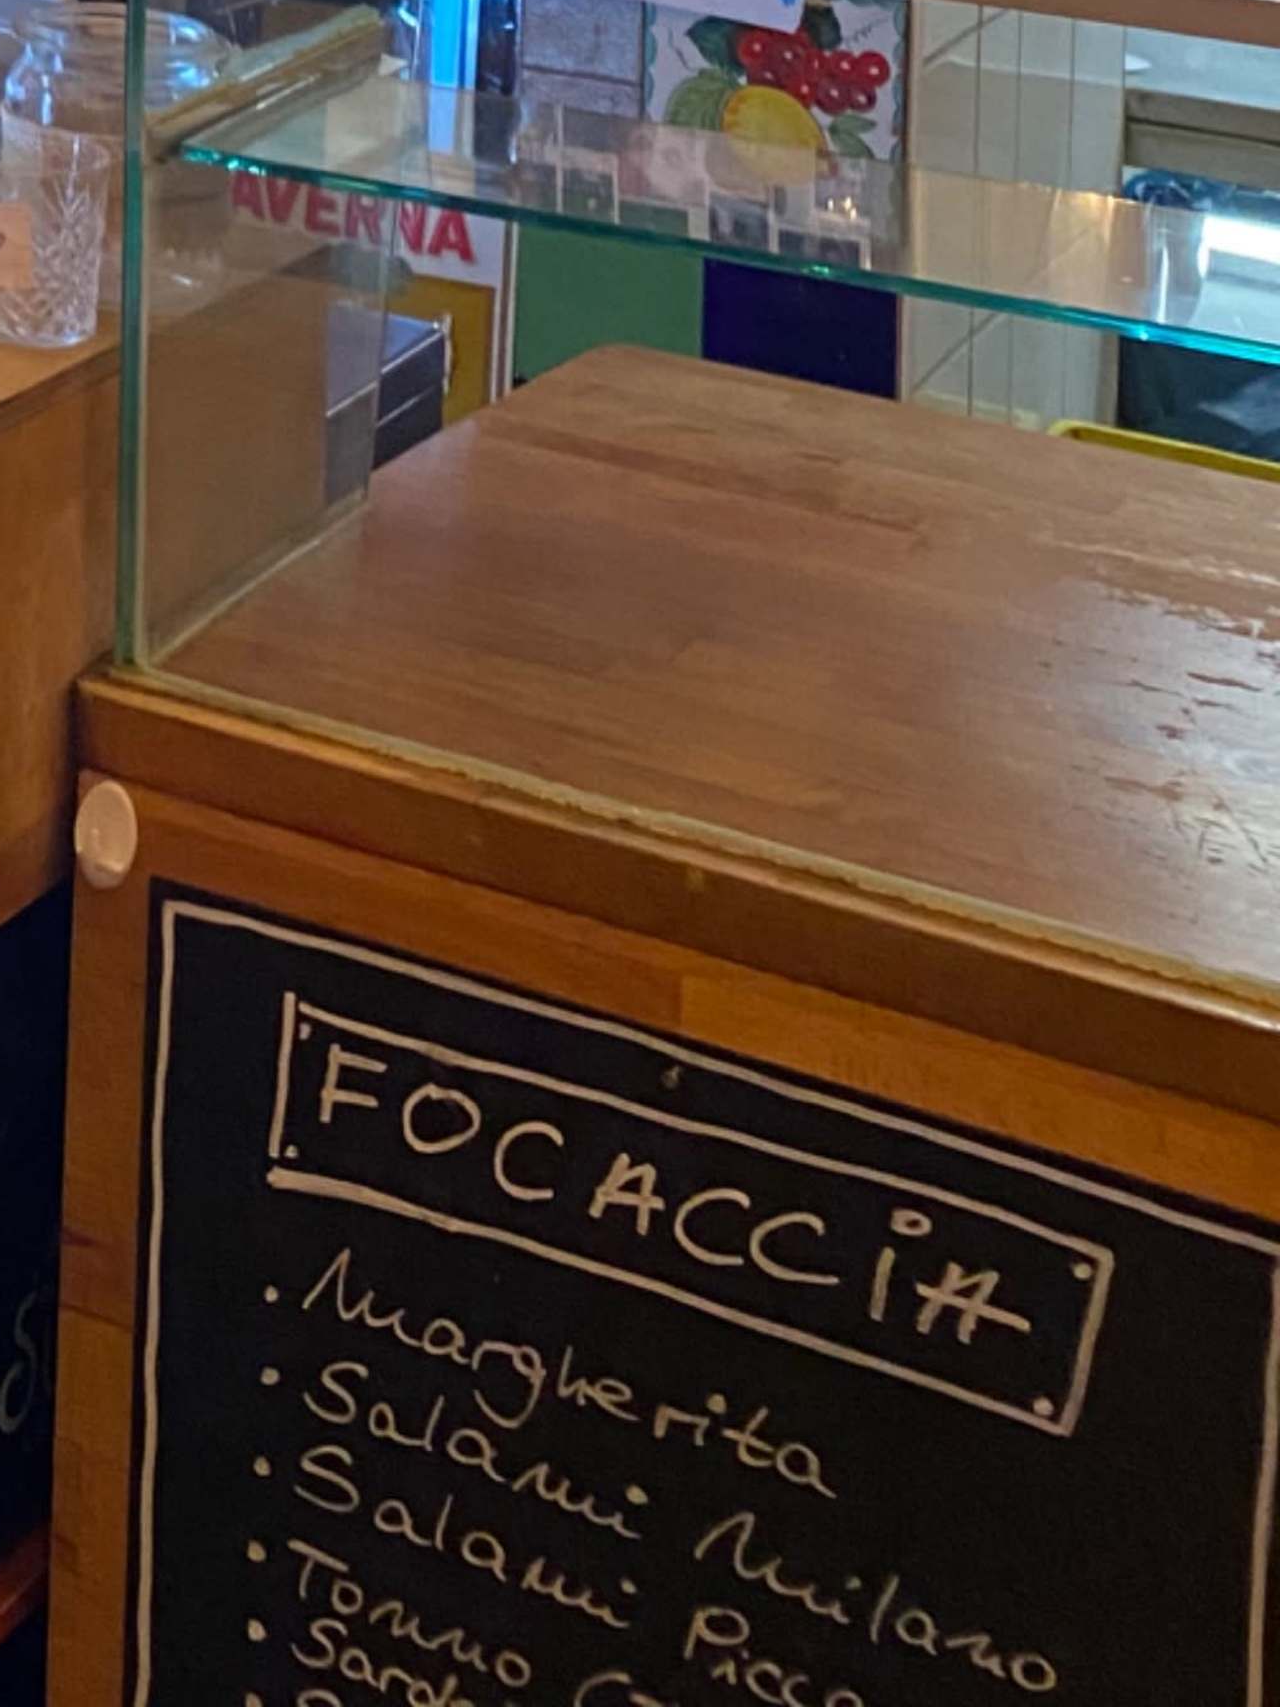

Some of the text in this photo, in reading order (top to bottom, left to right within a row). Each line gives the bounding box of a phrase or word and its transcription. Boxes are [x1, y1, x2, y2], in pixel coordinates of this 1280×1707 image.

[229, 172, 477, 264] AVERNA
[294, 1444, 639, 1629] Salami
[304, 1360, 648, 1540] Salami
